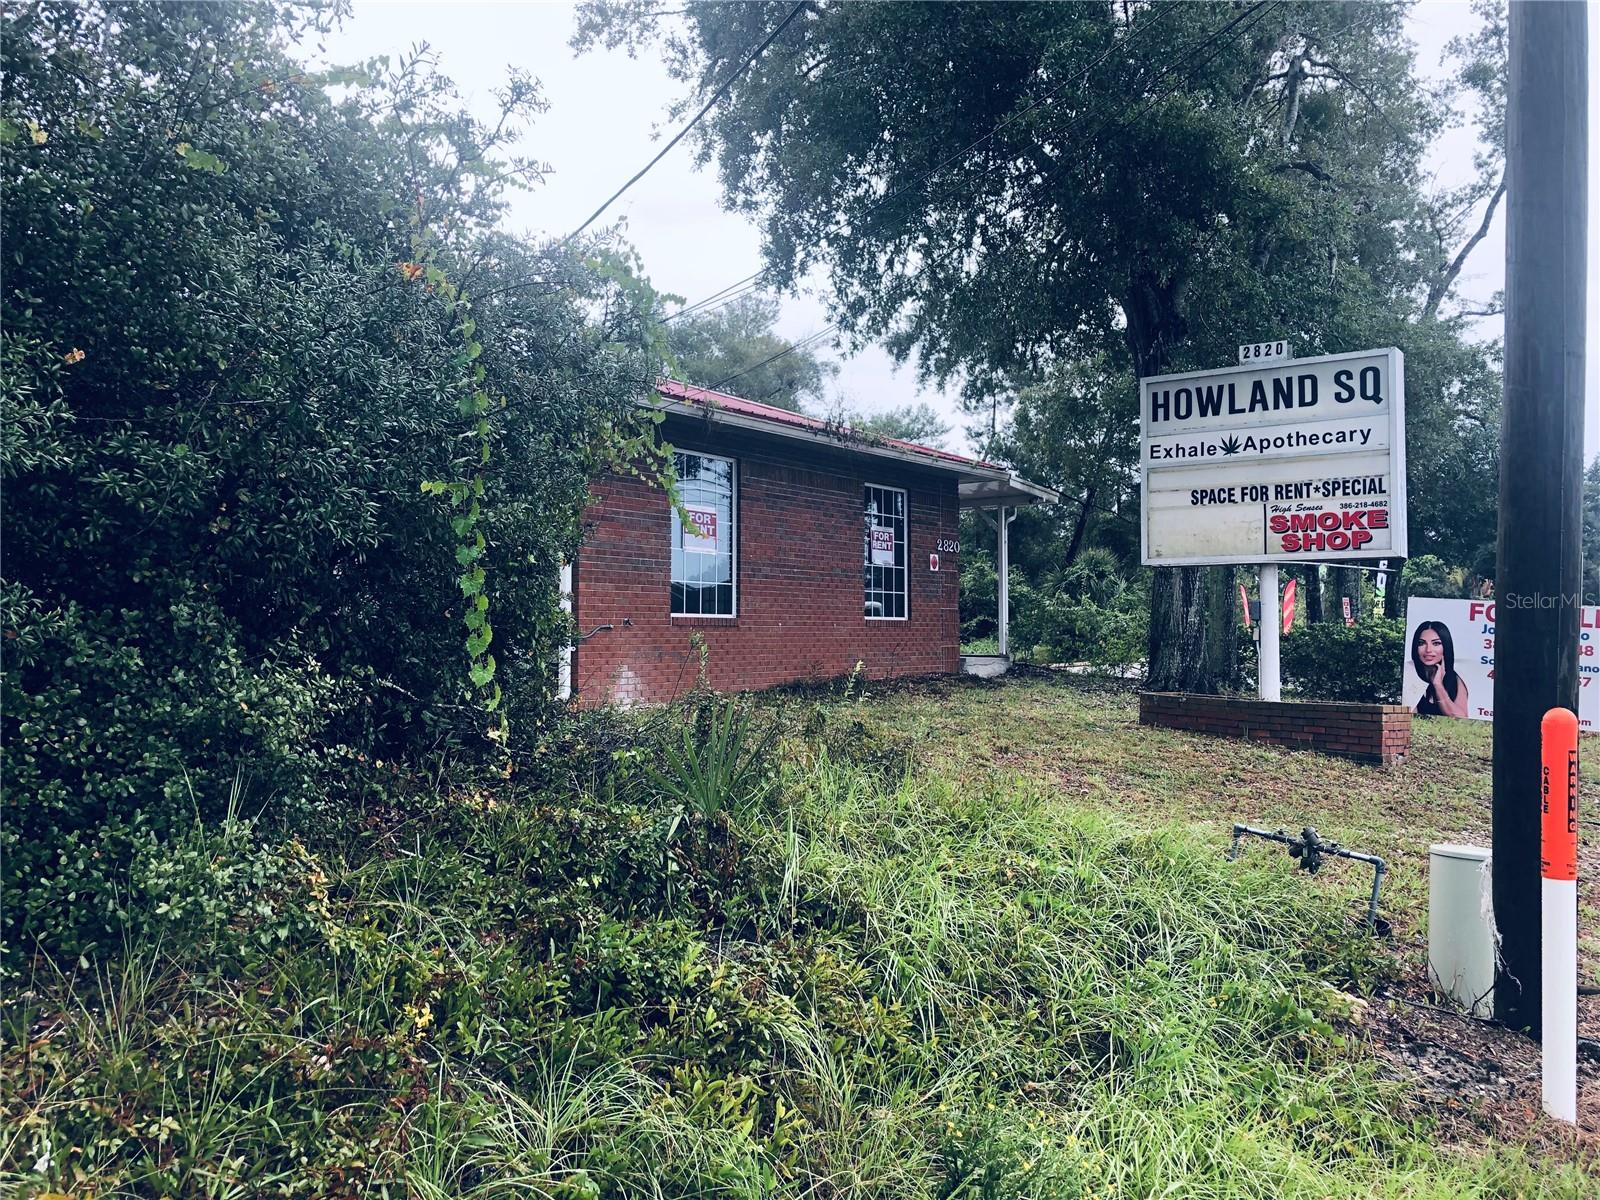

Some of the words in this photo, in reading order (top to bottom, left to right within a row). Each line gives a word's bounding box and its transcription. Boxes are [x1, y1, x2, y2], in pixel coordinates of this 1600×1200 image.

[1242, 342, 1284, 359] 2820
[1151, 373, 1319, 422] HOWLAND
[1334, 366, 1384, 405] SQ
[1150, 440, 1217, 460] Exhale
[1243, 427, 1372, 454] Apothecary
[1190, 487, 1236, 506] SPACE
[1240, 484, 1269, 503] FOR
[688, 511, 711, 524] FOR
[1270, 504, 1292, 515] High
[1295, 503, 1323, 512] Senses
[1269, 509, 1389, 534] SMOKE
[872, 540, 892, 551] RENT
[874, 531, 890, 541] FOR
[936, 538, 961, 553] 2820
[1281, 530, 1373, 552] SHOP
[1569, 751, 1577, 832] WARNING
